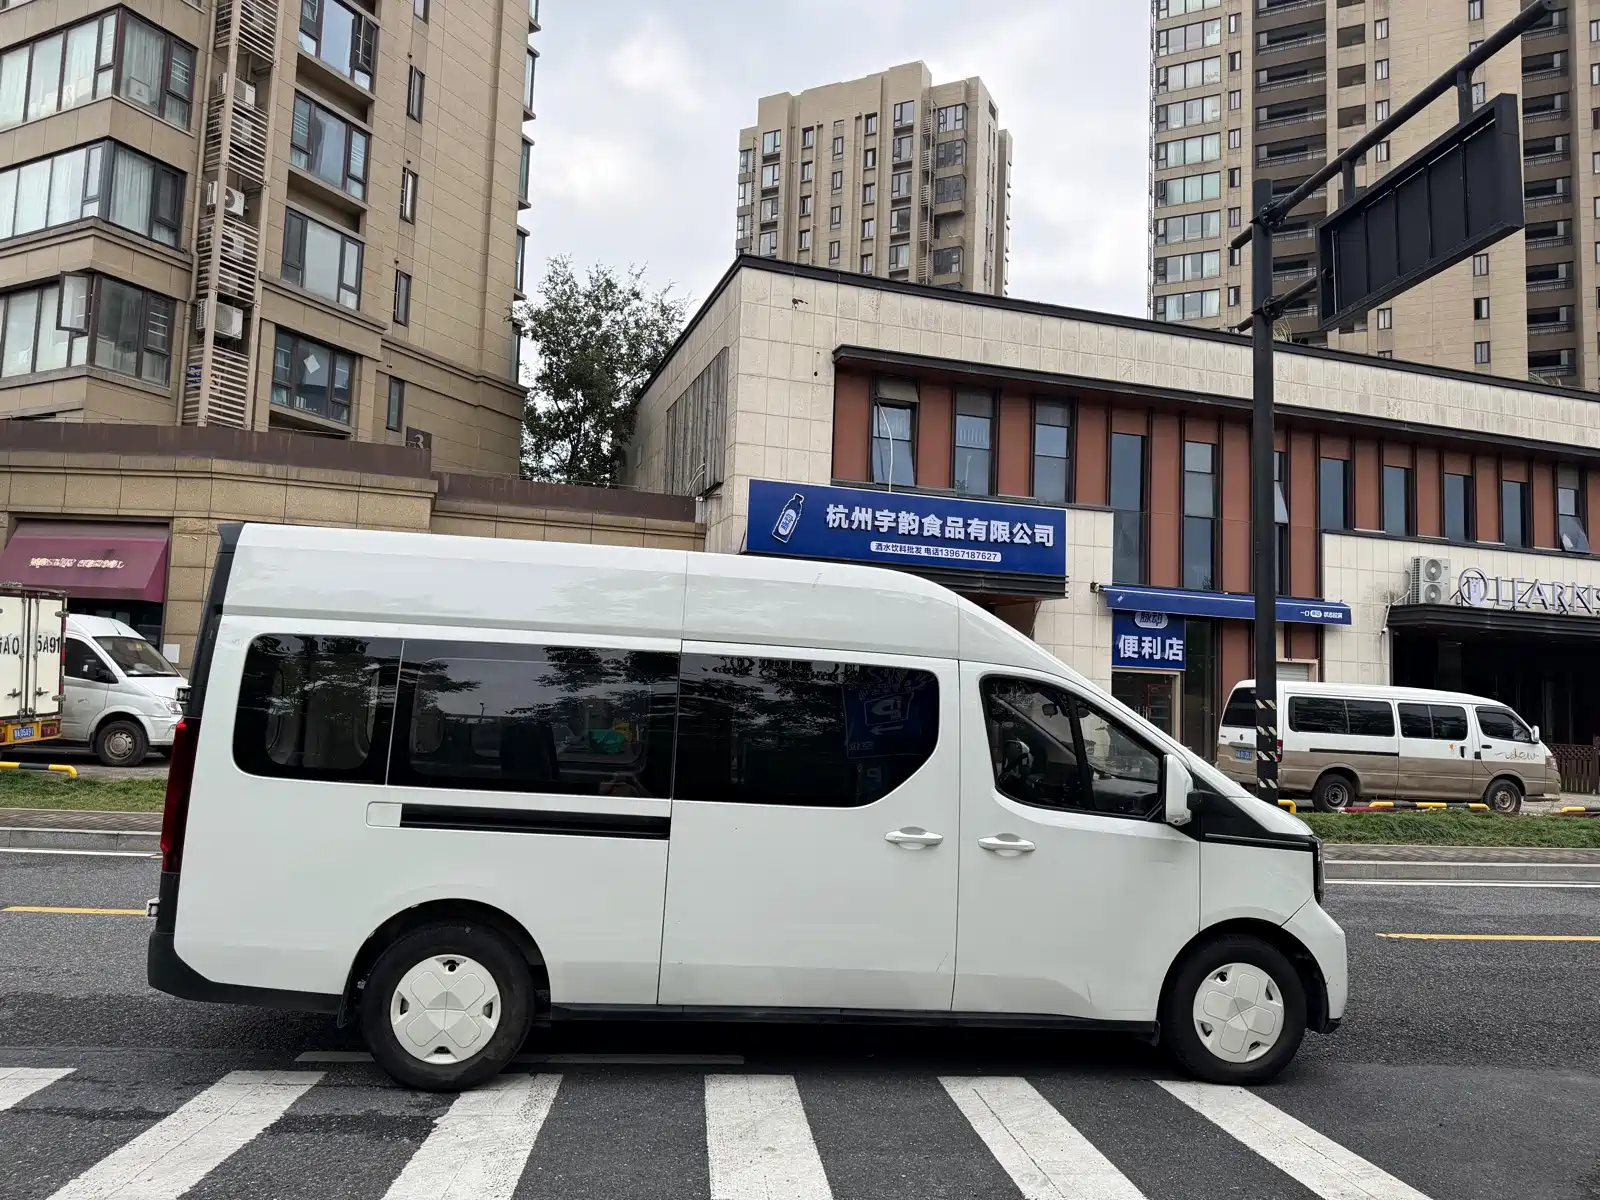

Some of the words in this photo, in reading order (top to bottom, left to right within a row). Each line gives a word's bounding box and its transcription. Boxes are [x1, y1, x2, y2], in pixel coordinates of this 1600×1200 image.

[826, 504, 1054, 547] 杭州宇韵食品有限公司
[875, 542, 922, 555] 酒水饮料批发
[924, 547, 998, 561] 电话13967187627
[1495, 576, 1600, 614] LEARN
[1119, 634, 1184, 661] 便利店
